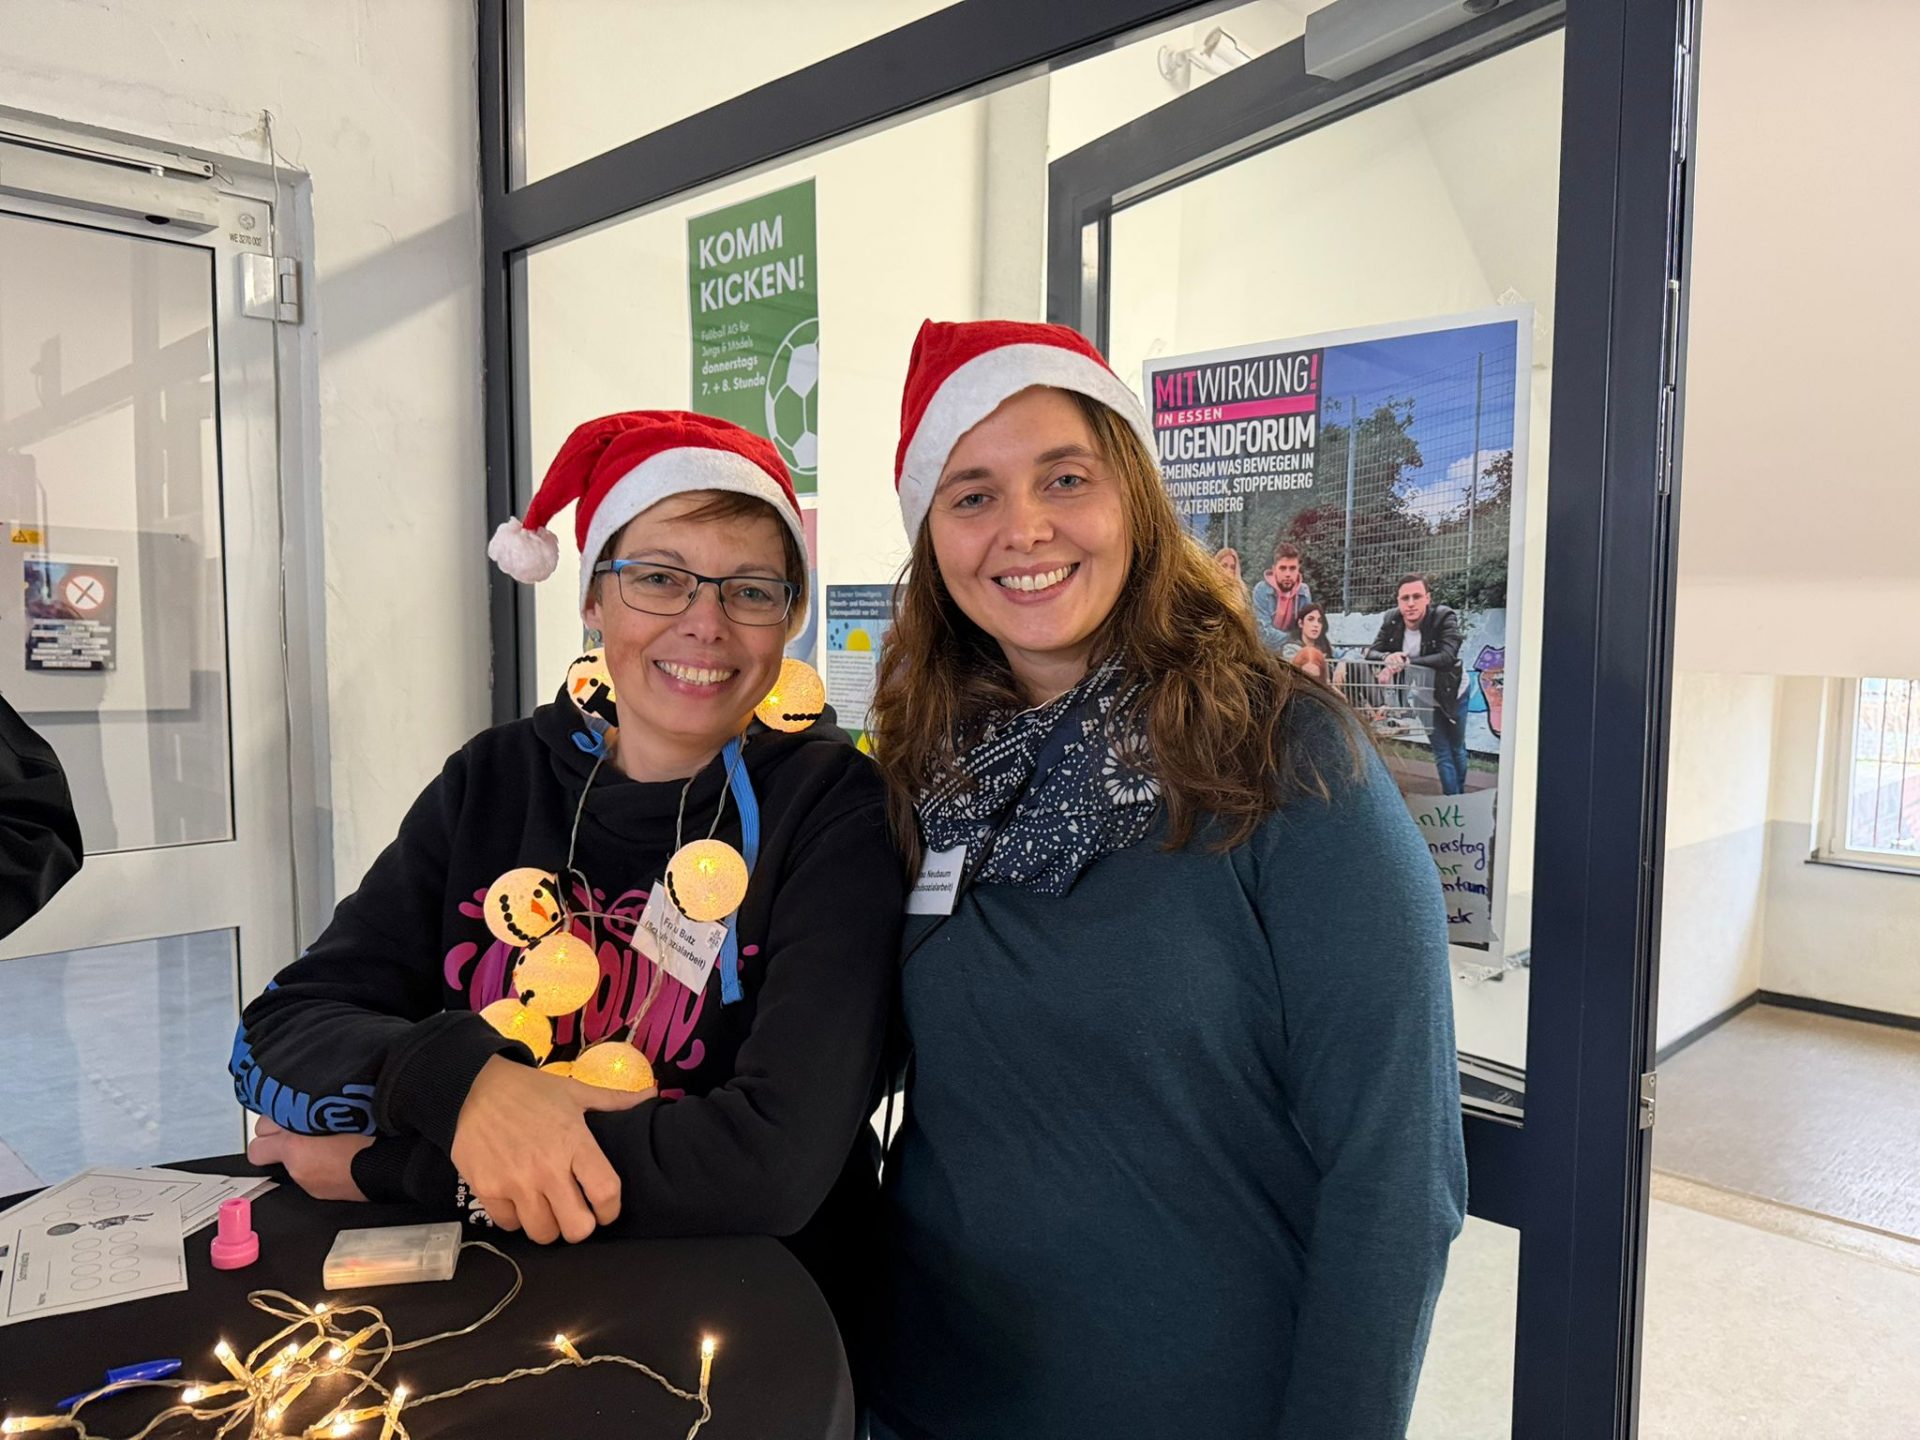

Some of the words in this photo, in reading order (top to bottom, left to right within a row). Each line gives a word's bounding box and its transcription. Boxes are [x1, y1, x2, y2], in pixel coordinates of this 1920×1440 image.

[699, 214, 783, 270] KOMM
[700, 254, 804, 313] KICKEN!
[727, 323, 738, 336] AG
[702, 355, 758, 375] donnerstags
[702, 382, 711, 396] 7.
[722, 378, 731, 392] 8.
[733, 371, 766, 390] Stunde
[1155, 353, 1319, 409] MITWIRKUNG!
[1158, 412, 1173, 425] IN
[1178, 407, 1222, 424] ESSEN
[1158, 414, 1316, 463] JUGENDFORUM
[1162, 459, 1215, 480] EMEINSAM
[1217, 459, 1242, 476] WAS
[1243, 454, 1299, 474] BEWEGEN
[1302, 452, 1314, 469] IN
[1233, 472, 1313, 494] STOPPENBERG
[679, 928, 696, 946] Butz
[455, 1185, 467, 1208] alps
